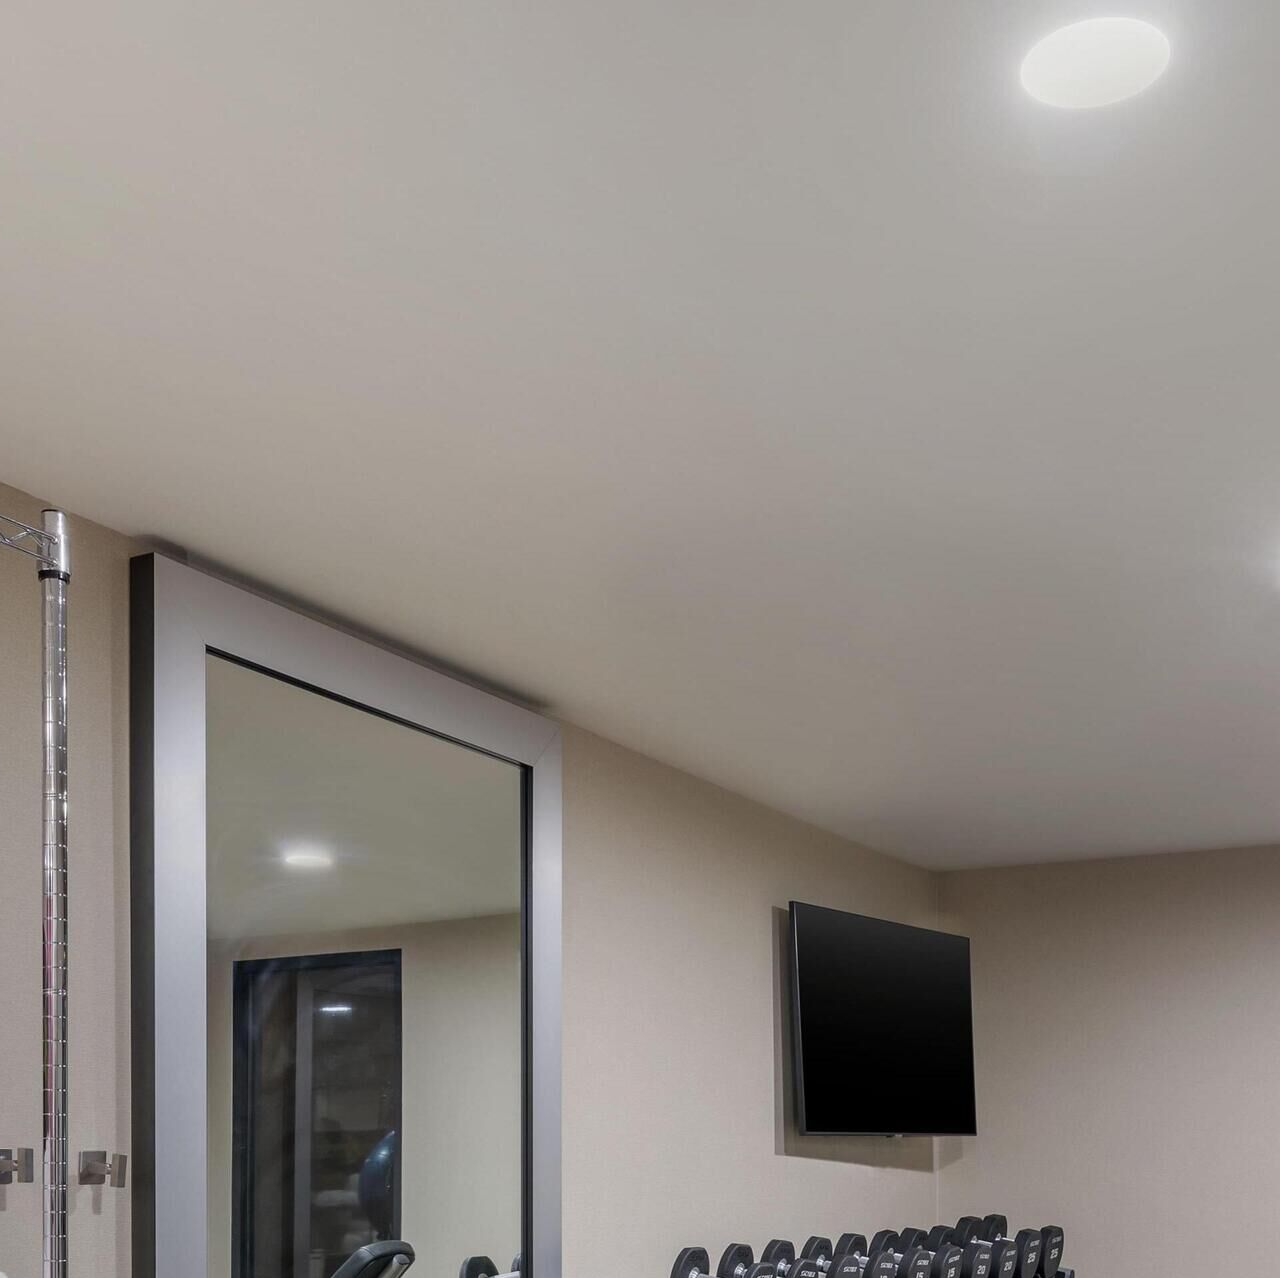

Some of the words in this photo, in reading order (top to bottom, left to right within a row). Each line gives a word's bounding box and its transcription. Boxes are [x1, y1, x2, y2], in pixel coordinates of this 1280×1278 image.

[1027, 1252, 1036, 1263] 25
[1050, 1248, 1059, 1260] 25
[977, 1265, 986, 1274] 20
[1004, 1261, 1013, 1271] 20
[947, 1267, 955, 1278] 15
